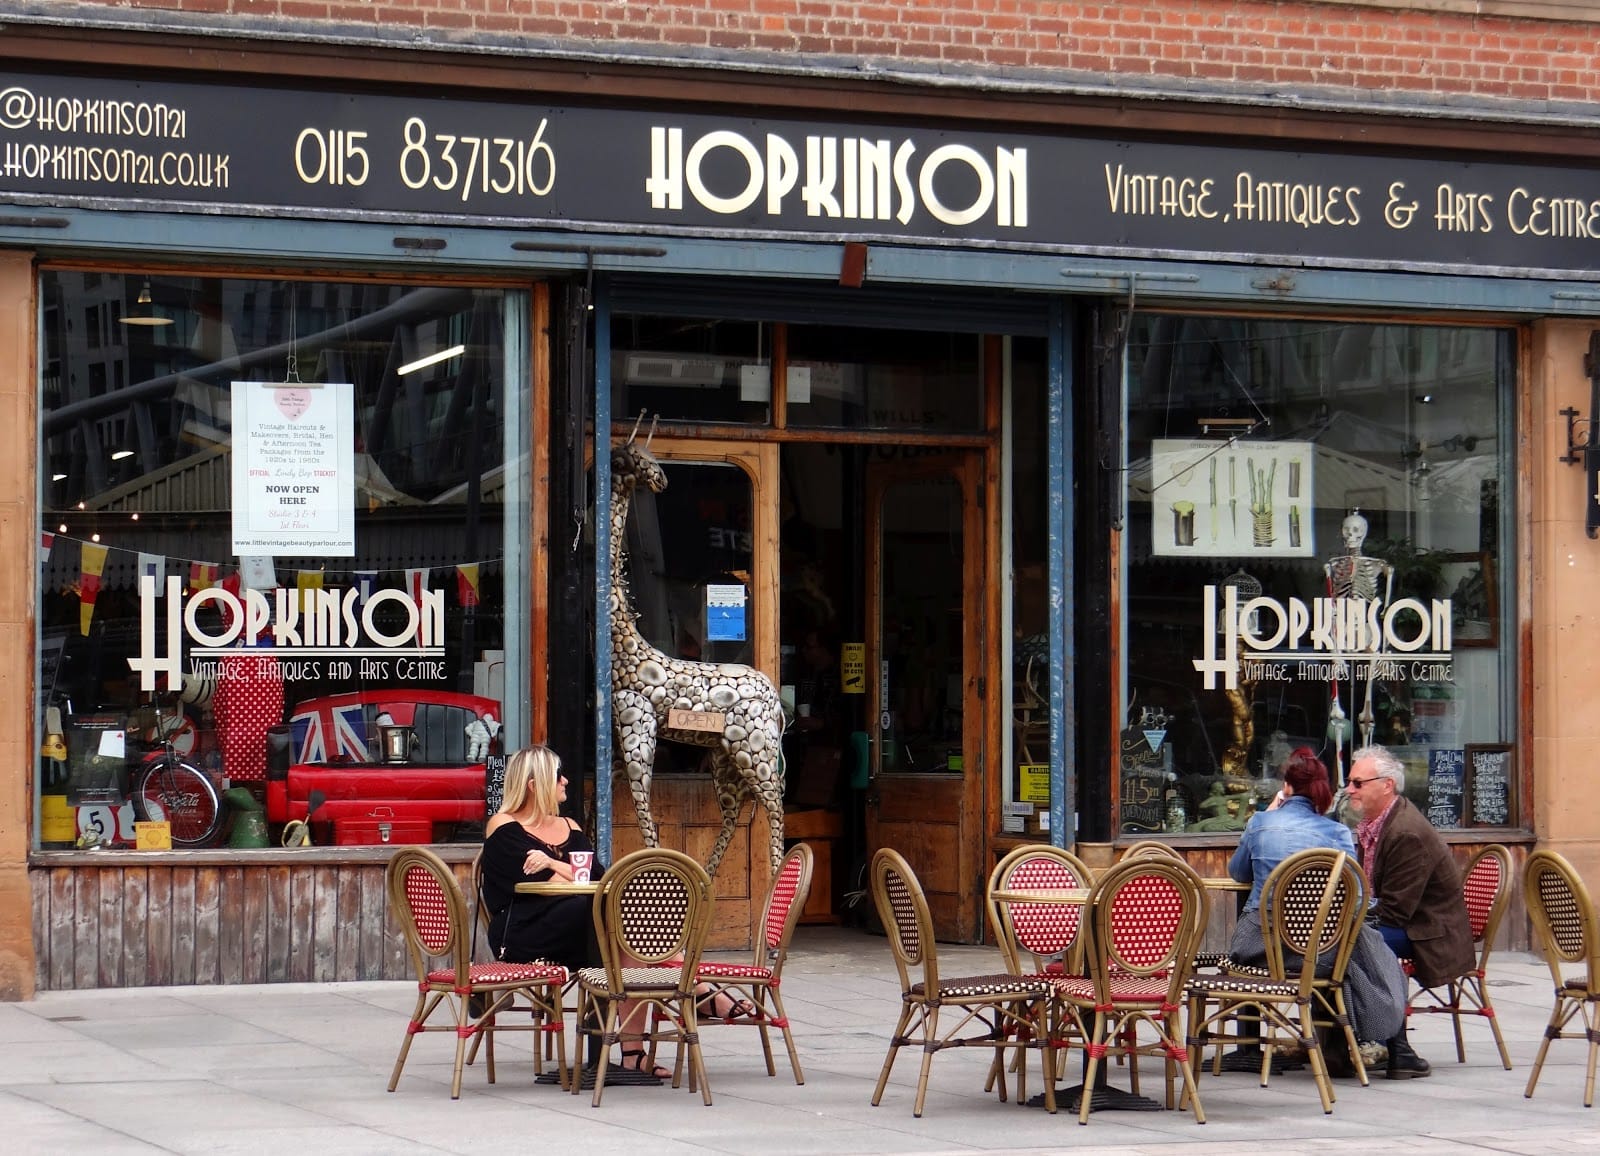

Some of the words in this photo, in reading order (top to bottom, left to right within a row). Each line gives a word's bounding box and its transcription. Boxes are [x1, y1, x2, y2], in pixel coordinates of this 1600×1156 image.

[295, 127, 370, 186] 0115
[400, 116, 556, 201] 8371316
[646, 127, 1028, 227] HOPKINSON
[1233, 172, 1361, 228] ANTIQUES
[1384, 182, 1419, 229] &
[1434, 184, 1493, 232] ARTS
[1507, 188, 1600, 239] CENTRE
[266, 485, 290, 494] NOW
[293, 486, 320, 494] OPEN
[280, 497, 307, 505] HERE
[126, 575, 445, 691] HOPKINSON
[1192, 584, 1453, 690] HOPKINSON
[257, 657, 321, 681] ANTIQUES
[327, 659, 352, 680] AND
[359, 658, 390, 680] ARTS
[396, 658, 448, 680] CENTRE
[1411, 660, 1454, 681] CENTRE
[677, 712, 716, 729] OPEN
[89, 810, 105, 835] 5
